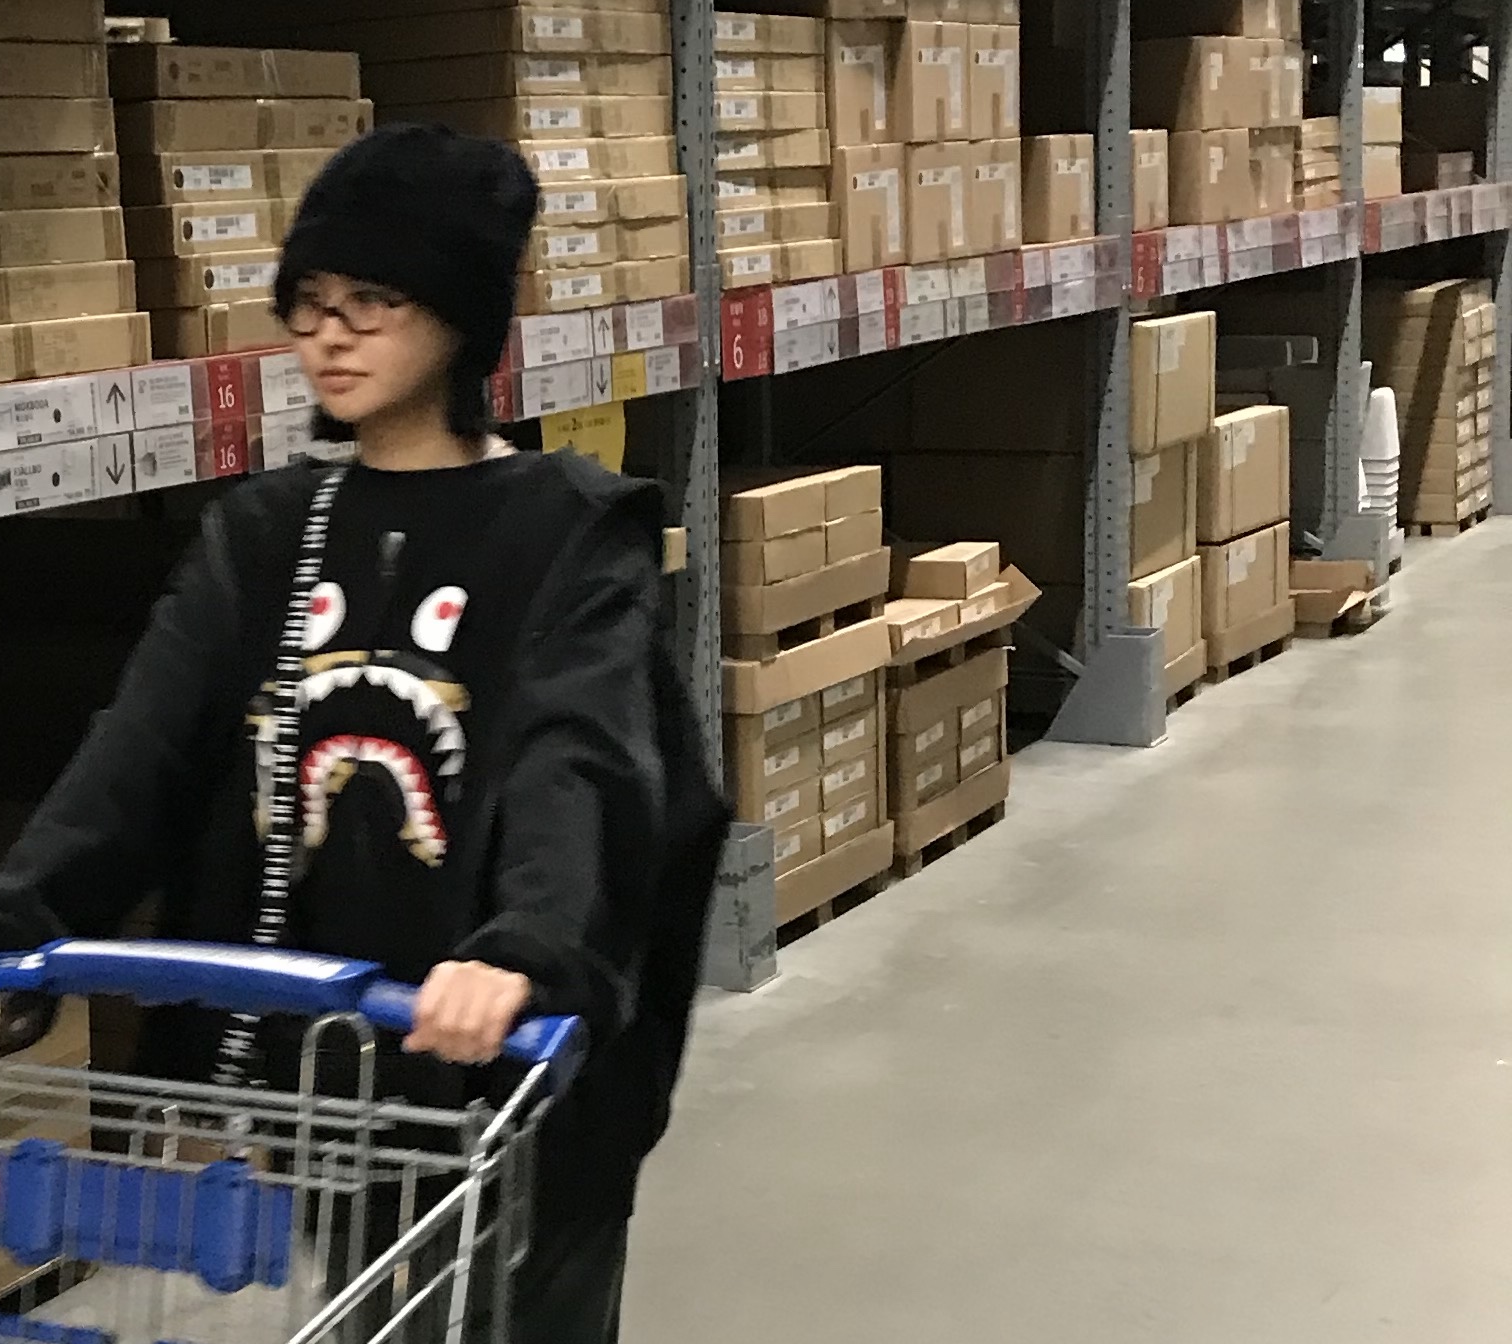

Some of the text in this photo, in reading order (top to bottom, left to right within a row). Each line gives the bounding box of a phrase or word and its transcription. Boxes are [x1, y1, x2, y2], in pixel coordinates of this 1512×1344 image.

[733, 334, 744, 369] 6
[218, 383, 235, 409] 16
[220, 444, 237, 470] 16
